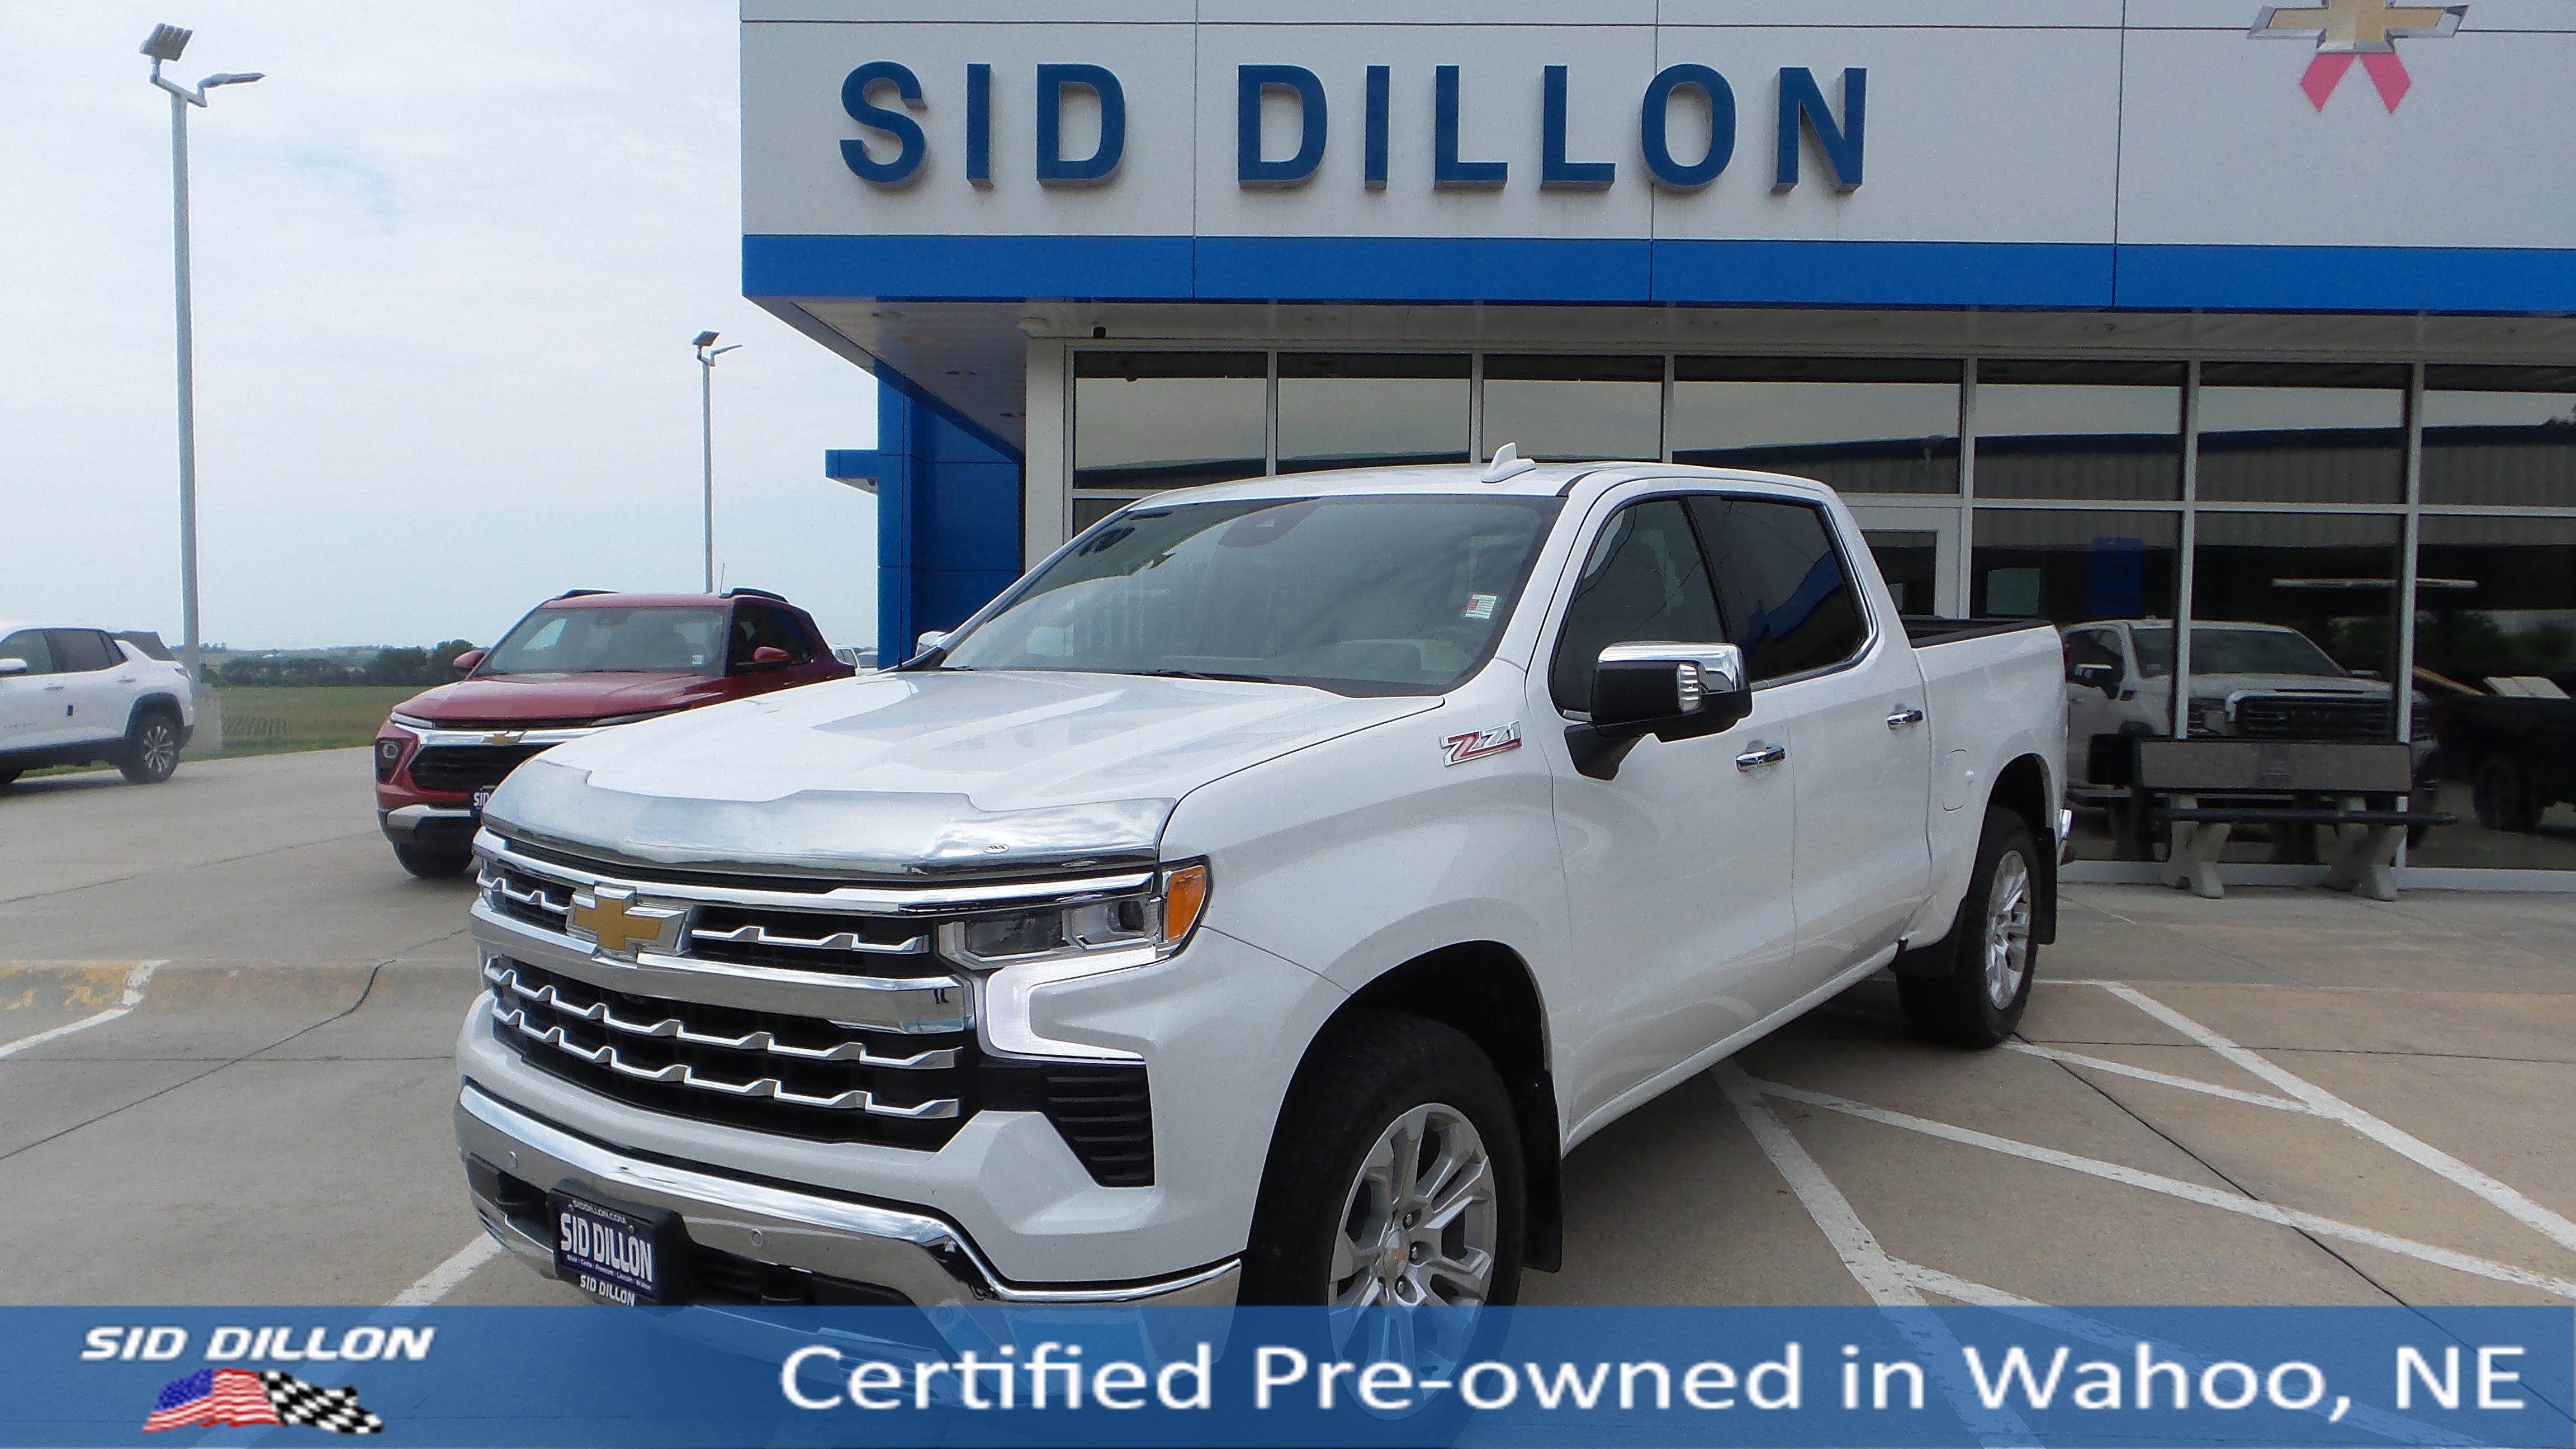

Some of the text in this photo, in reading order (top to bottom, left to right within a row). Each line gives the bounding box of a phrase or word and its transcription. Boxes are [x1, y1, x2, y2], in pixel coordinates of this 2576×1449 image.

[839, 60, 1868, 193] SID DILLON
[1439, 721, 1522, 766] Z71
[561, 1213, 652, 1282] SID DILLON
[580, 1275, 596, 1292] SID
[599, 1281, 635, 1306] DILLON
